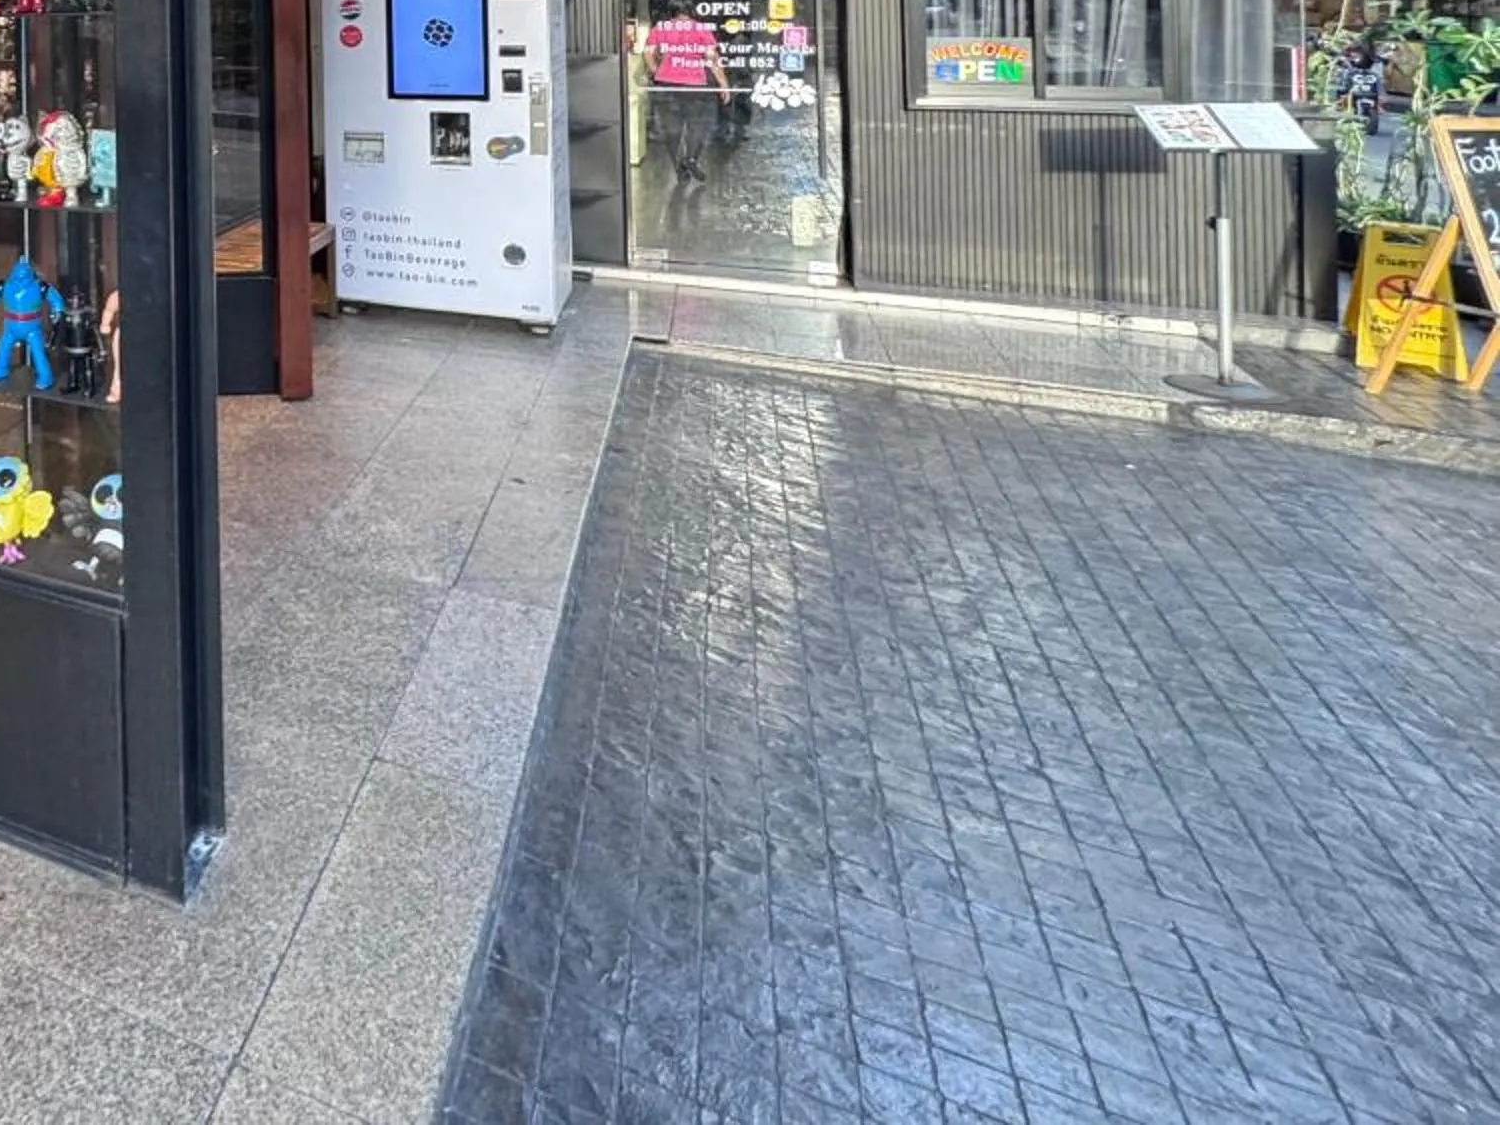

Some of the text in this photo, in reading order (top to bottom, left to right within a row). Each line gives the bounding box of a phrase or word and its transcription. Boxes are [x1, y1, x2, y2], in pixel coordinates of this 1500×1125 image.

[695, 1, 751, 16] OPEN
[718, 41, 754, 54] Your
[931, 41, 1029, 61] WELCOME
[934, 59, 1025, 83] OPEN
